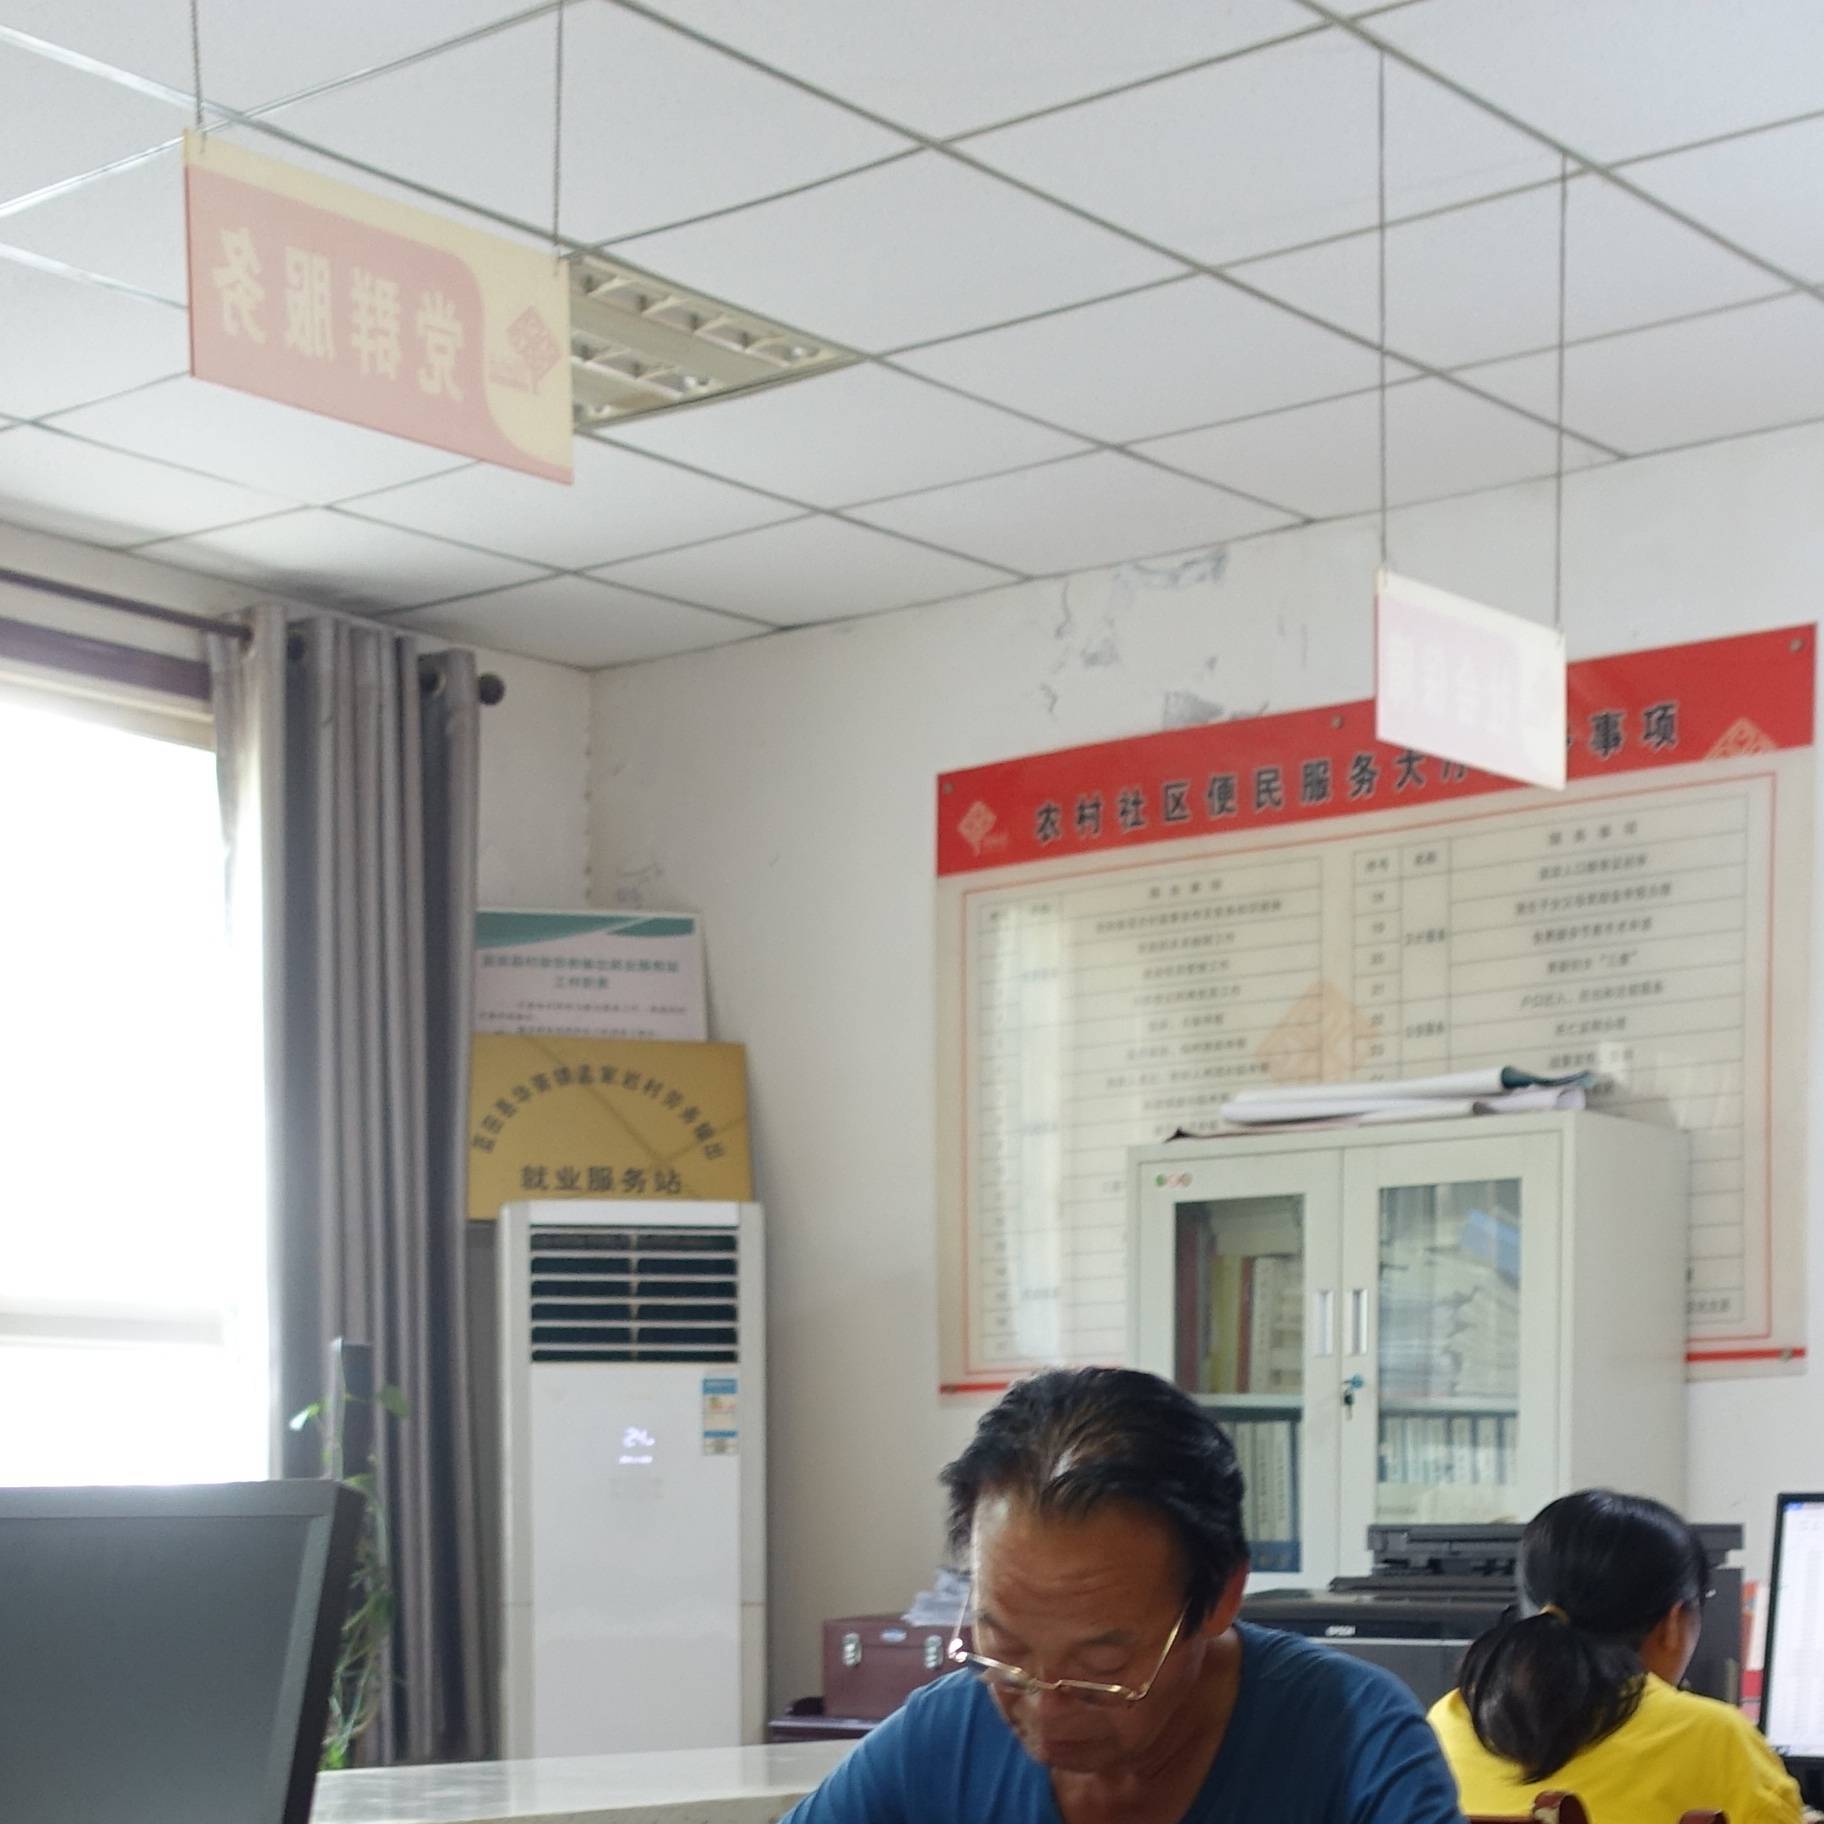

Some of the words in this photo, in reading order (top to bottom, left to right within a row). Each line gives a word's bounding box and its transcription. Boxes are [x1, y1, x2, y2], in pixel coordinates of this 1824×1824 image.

[520, 1164, 683, 1194] 就业服务站
